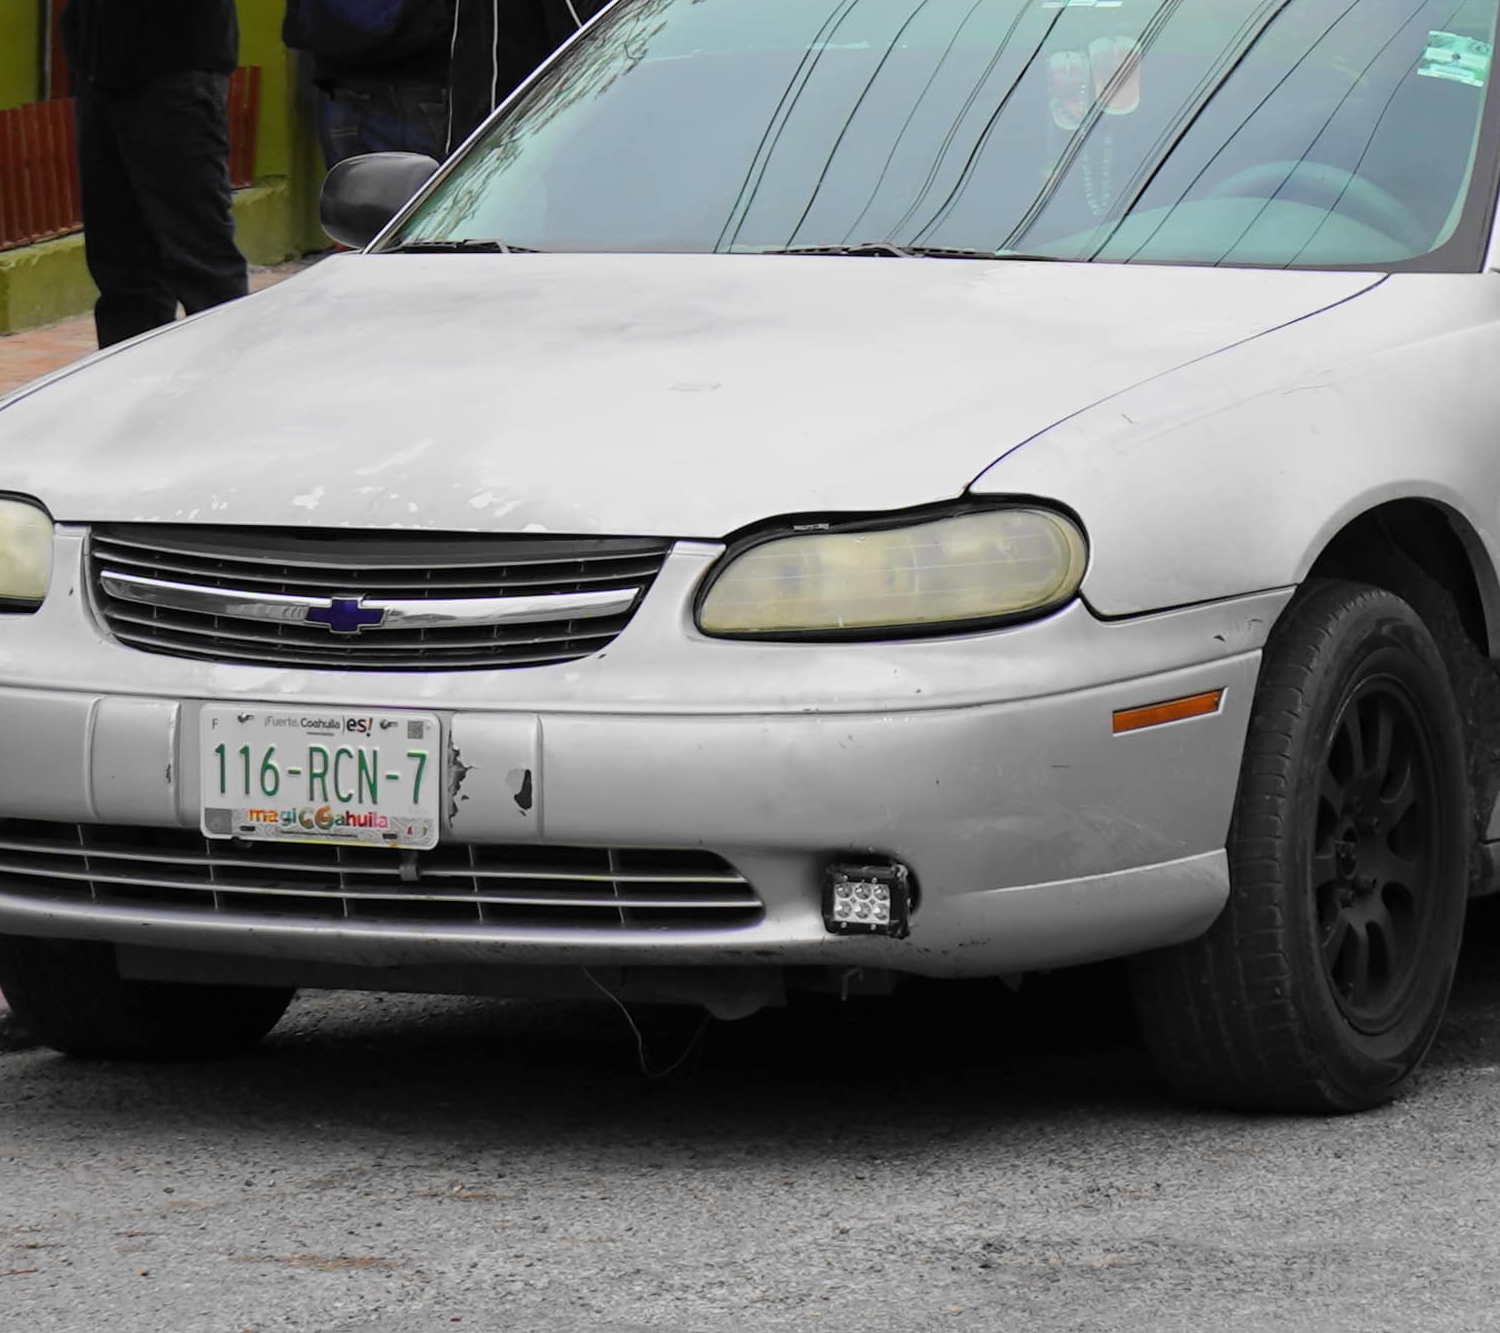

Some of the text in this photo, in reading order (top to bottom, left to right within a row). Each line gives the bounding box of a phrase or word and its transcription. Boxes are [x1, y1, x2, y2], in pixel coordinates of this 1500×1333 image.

[300, 717, 341, 729] Coahuila
[347, 717, 373, 737] es!
[215, 743, 428, 805] 116-RCN-7
